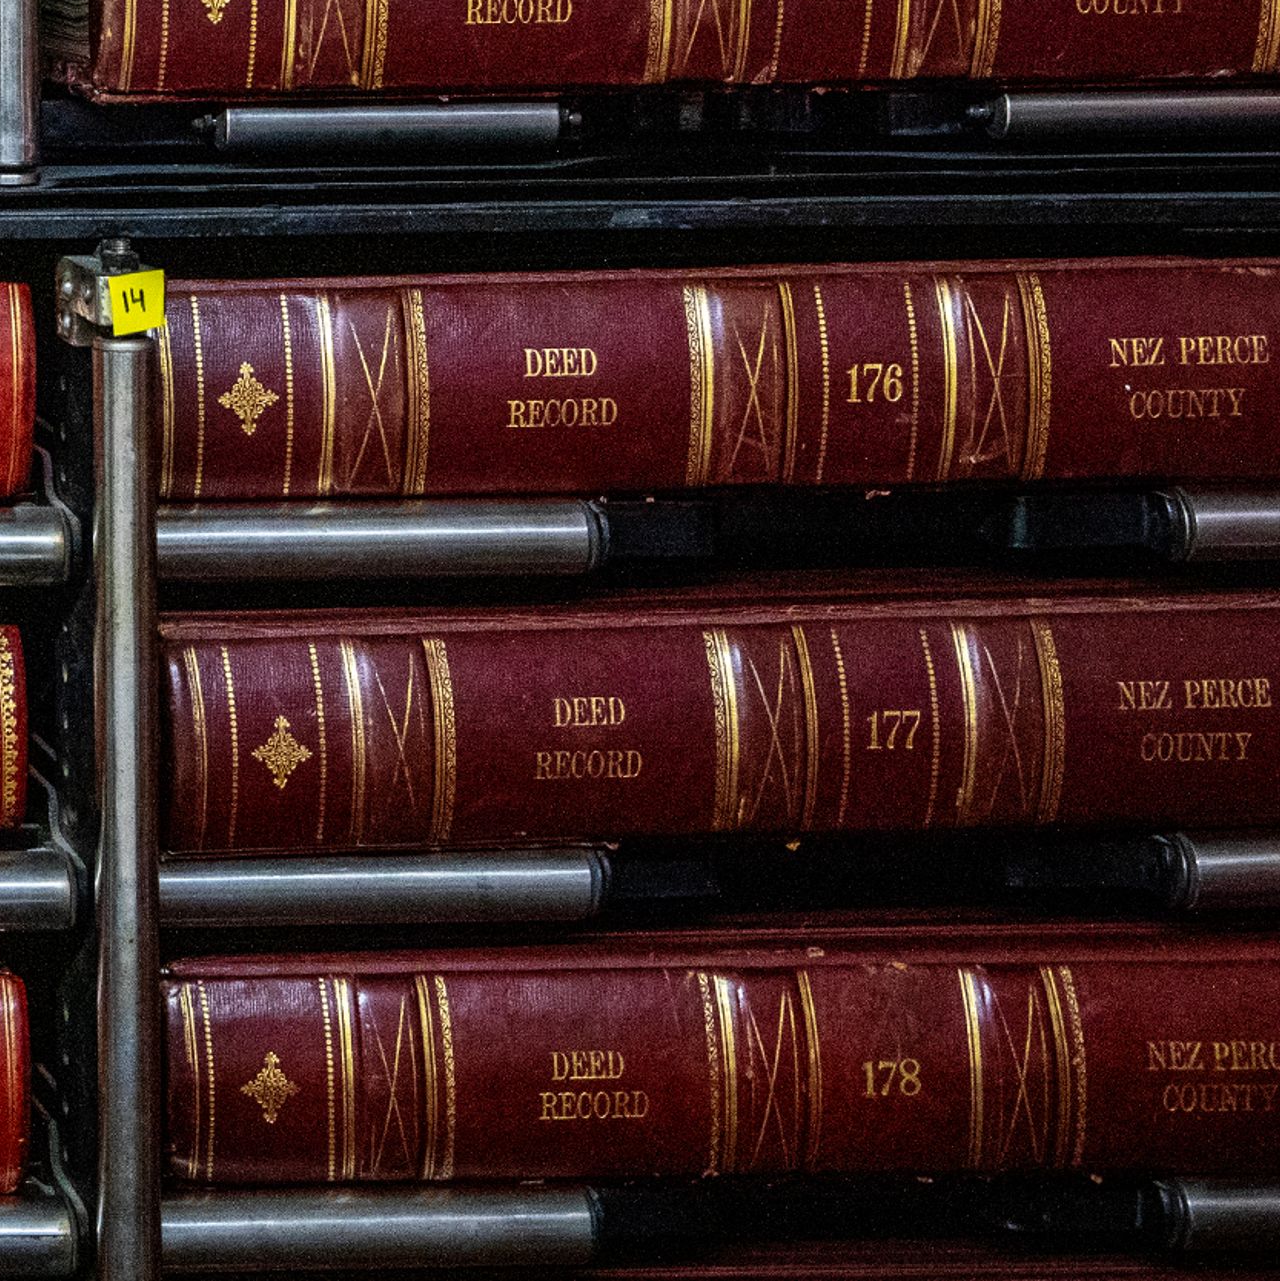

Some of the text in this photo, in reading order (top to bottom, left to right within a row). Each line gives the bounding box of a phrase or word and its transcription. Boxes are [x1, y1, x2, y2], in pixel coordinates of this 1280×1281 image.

[122, 287, 145, 313] 14
[524, 349, 597, 377] DEED
[1109, 336, 1269, 366] NEZ PERCE
[845, 363, 902, 403] 176
[507, 399, 618, 429] RECORD
[1130, 388, 1244, 418] COUNTY
[1117, 678, 1271, 709] NEZ PERCE
[554, 698, 625, 727] DEED
[866, 711, 921, 751] 177
[1140, 733, 1252, 762] COUNTY
[536, 750, 641, 780] RECORD
[551, 1052, 624, 1081] DEED
[1146, 1040, 1204, 1070] NEZ
[861, 1058, 921, 1098] 178
[540, 1090, 649, 1120] RECORD
[1163, 1084, 1278, 1112] COUNTY
